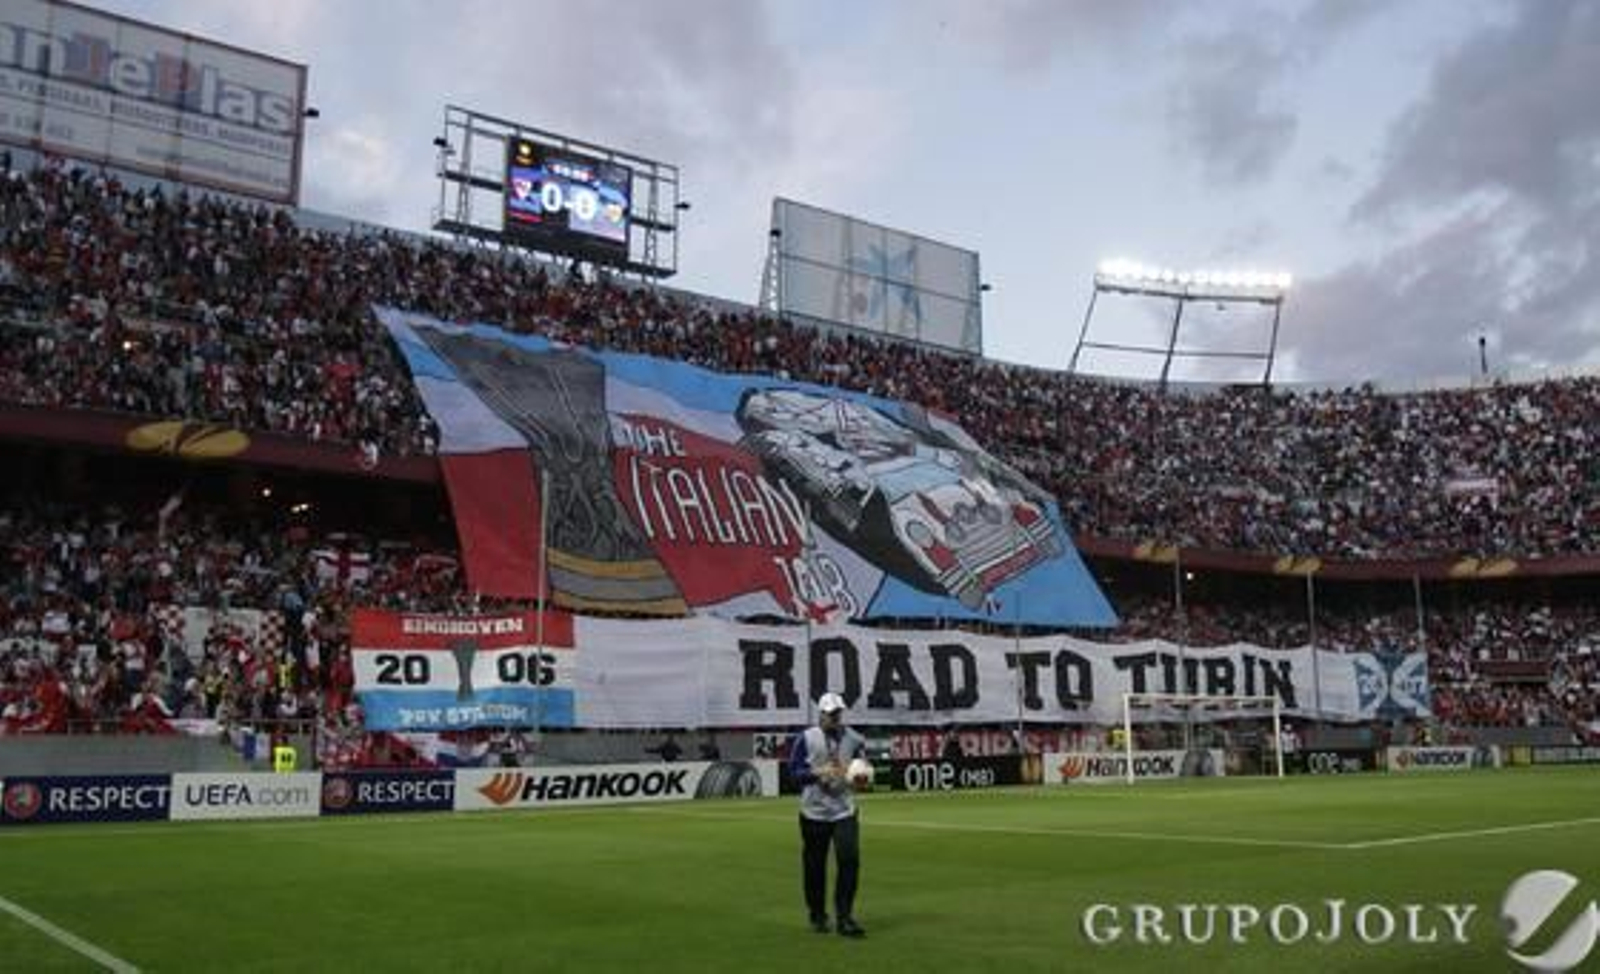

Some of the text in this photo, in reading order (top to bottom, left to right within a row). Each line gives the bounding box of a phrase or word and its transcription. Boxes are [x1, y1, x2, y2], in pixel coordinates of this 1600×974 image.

[631, 455, 812, 546] ITALIAN
[376, 653, 556, 686] 20 06
[739, 636, 1299, 711] ROAD TO TURIN
[358, 780, 454, 802] RESPECT
[904, 763, 955, 792] one
[50, 785, 168, 811] RESPECT
[187, 783, 308, 806] UEFA.com
